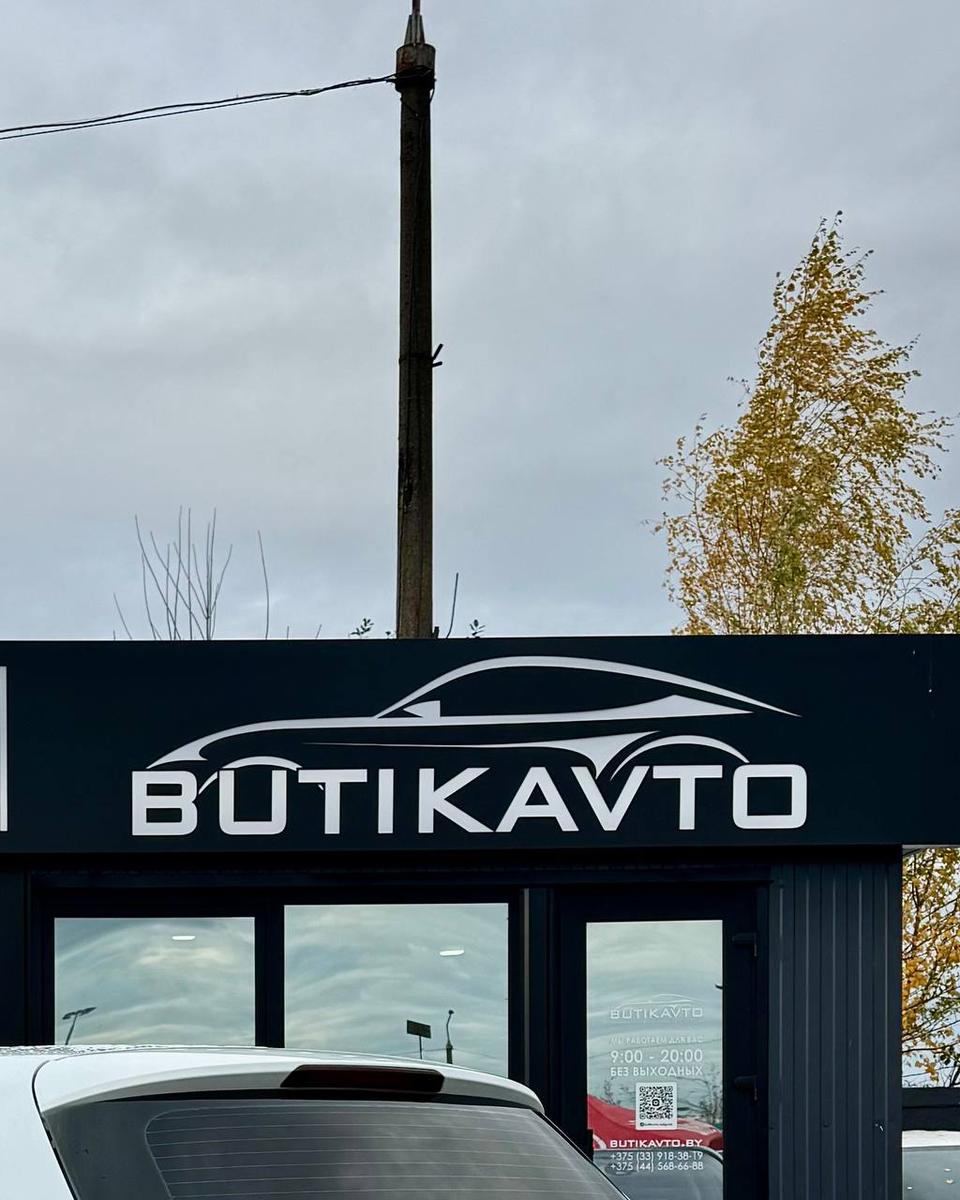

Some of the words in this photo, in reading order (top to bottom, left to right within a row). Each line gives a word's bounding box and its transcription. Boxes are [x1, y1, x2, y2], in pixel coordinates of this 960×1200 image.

[131, 763, 809, 837] BUTIKAVTO
[610, 1007, 703, 1019] BUTIKAVTO
[610, 1049, 643, 1063] 9:00
[660, 1049, 703, 1062] 20:00
[610, 1067, 629, 1077] БЕЗ
[633, 1066, 703, 1077] ВЫХОДНЫХ
[610, 1139, 703, 1148] BUTIKAVTO.BY
[610, 1151, 634, 1161] +375
[636, 1151, 654, 1163] (33)
[657, 1151, 704, 1161] 918-38-19
[610, 1161, 634, 1171] +375
[636, 1161, 654, 1173] (44)
[657, 1161, 704, 1171] 568-66-88
